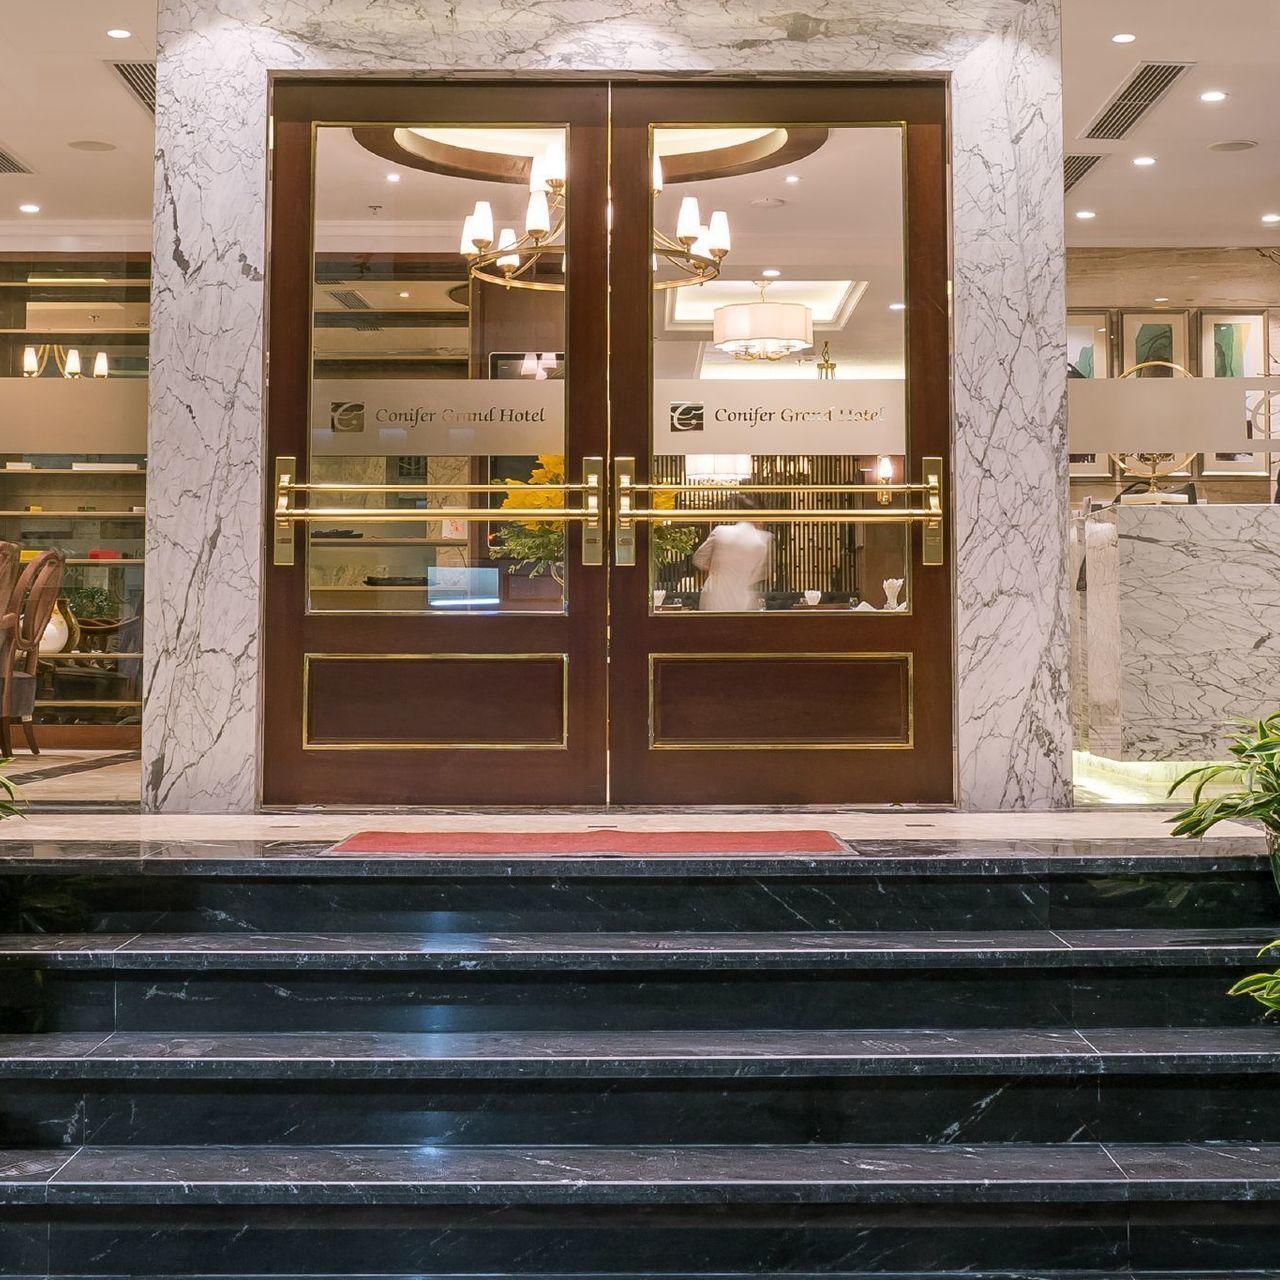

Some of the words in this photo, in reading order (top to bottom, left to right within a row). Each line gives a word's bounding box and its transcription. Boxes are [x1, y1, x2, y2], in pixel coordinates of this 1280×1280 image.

[375, 406, 438, 428] Conifer
[440, 406, 497, 423] Grand
[499, 406, 546, 423] Hotel
[714, 406, 776, 428] Conifer
